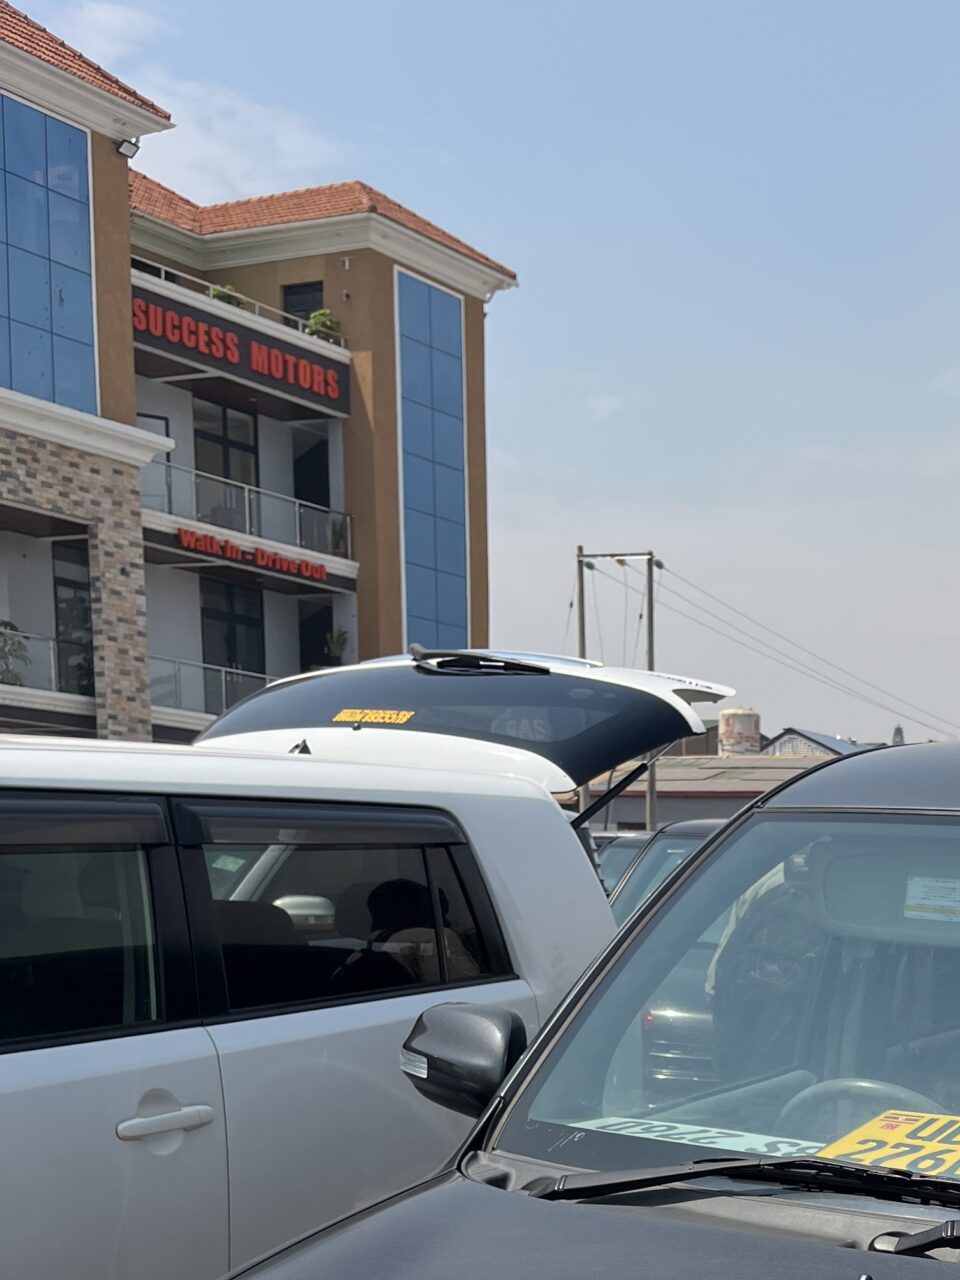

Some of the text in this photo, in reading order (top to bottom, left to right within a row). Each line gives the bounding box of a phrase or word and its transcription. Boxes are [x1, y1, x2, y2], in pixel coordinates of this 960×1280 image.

[132, 297, 339, 399] SUCCESS MOTORS
[178, 528, 222, 556] Walk
[255, 547, 298, 573] Drive
[301, 559, 327, 581] Out
[596, 1121, 744, 1145] 276D
